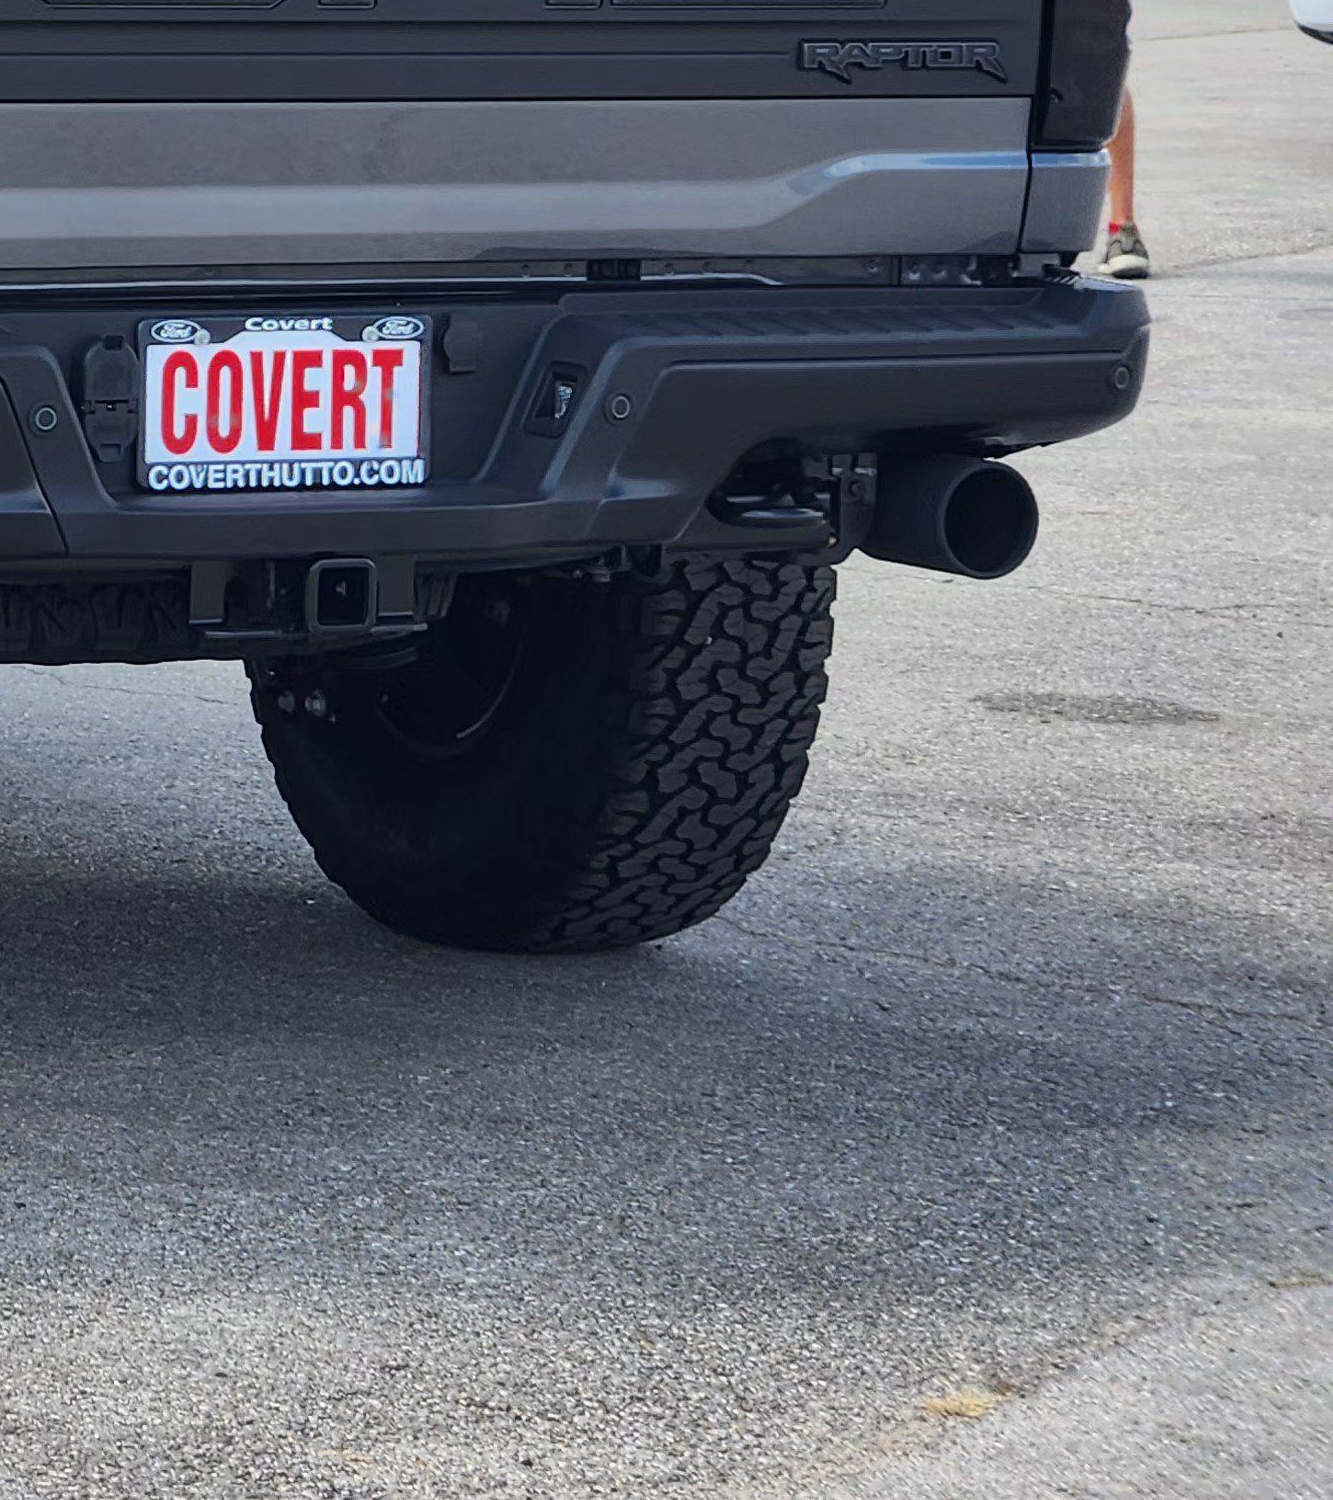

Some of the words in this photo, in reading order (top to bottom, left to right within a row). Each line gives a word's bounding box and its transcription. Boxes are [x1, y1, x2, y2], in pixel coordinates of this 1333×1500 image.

[798, 37, 1008, 84] RAPTOR
[244, 316, 333, 331] Covert
[160, 349, 404, 455] COVERT
[148, 457, 425, 490] COVERTHUTTO.COM
